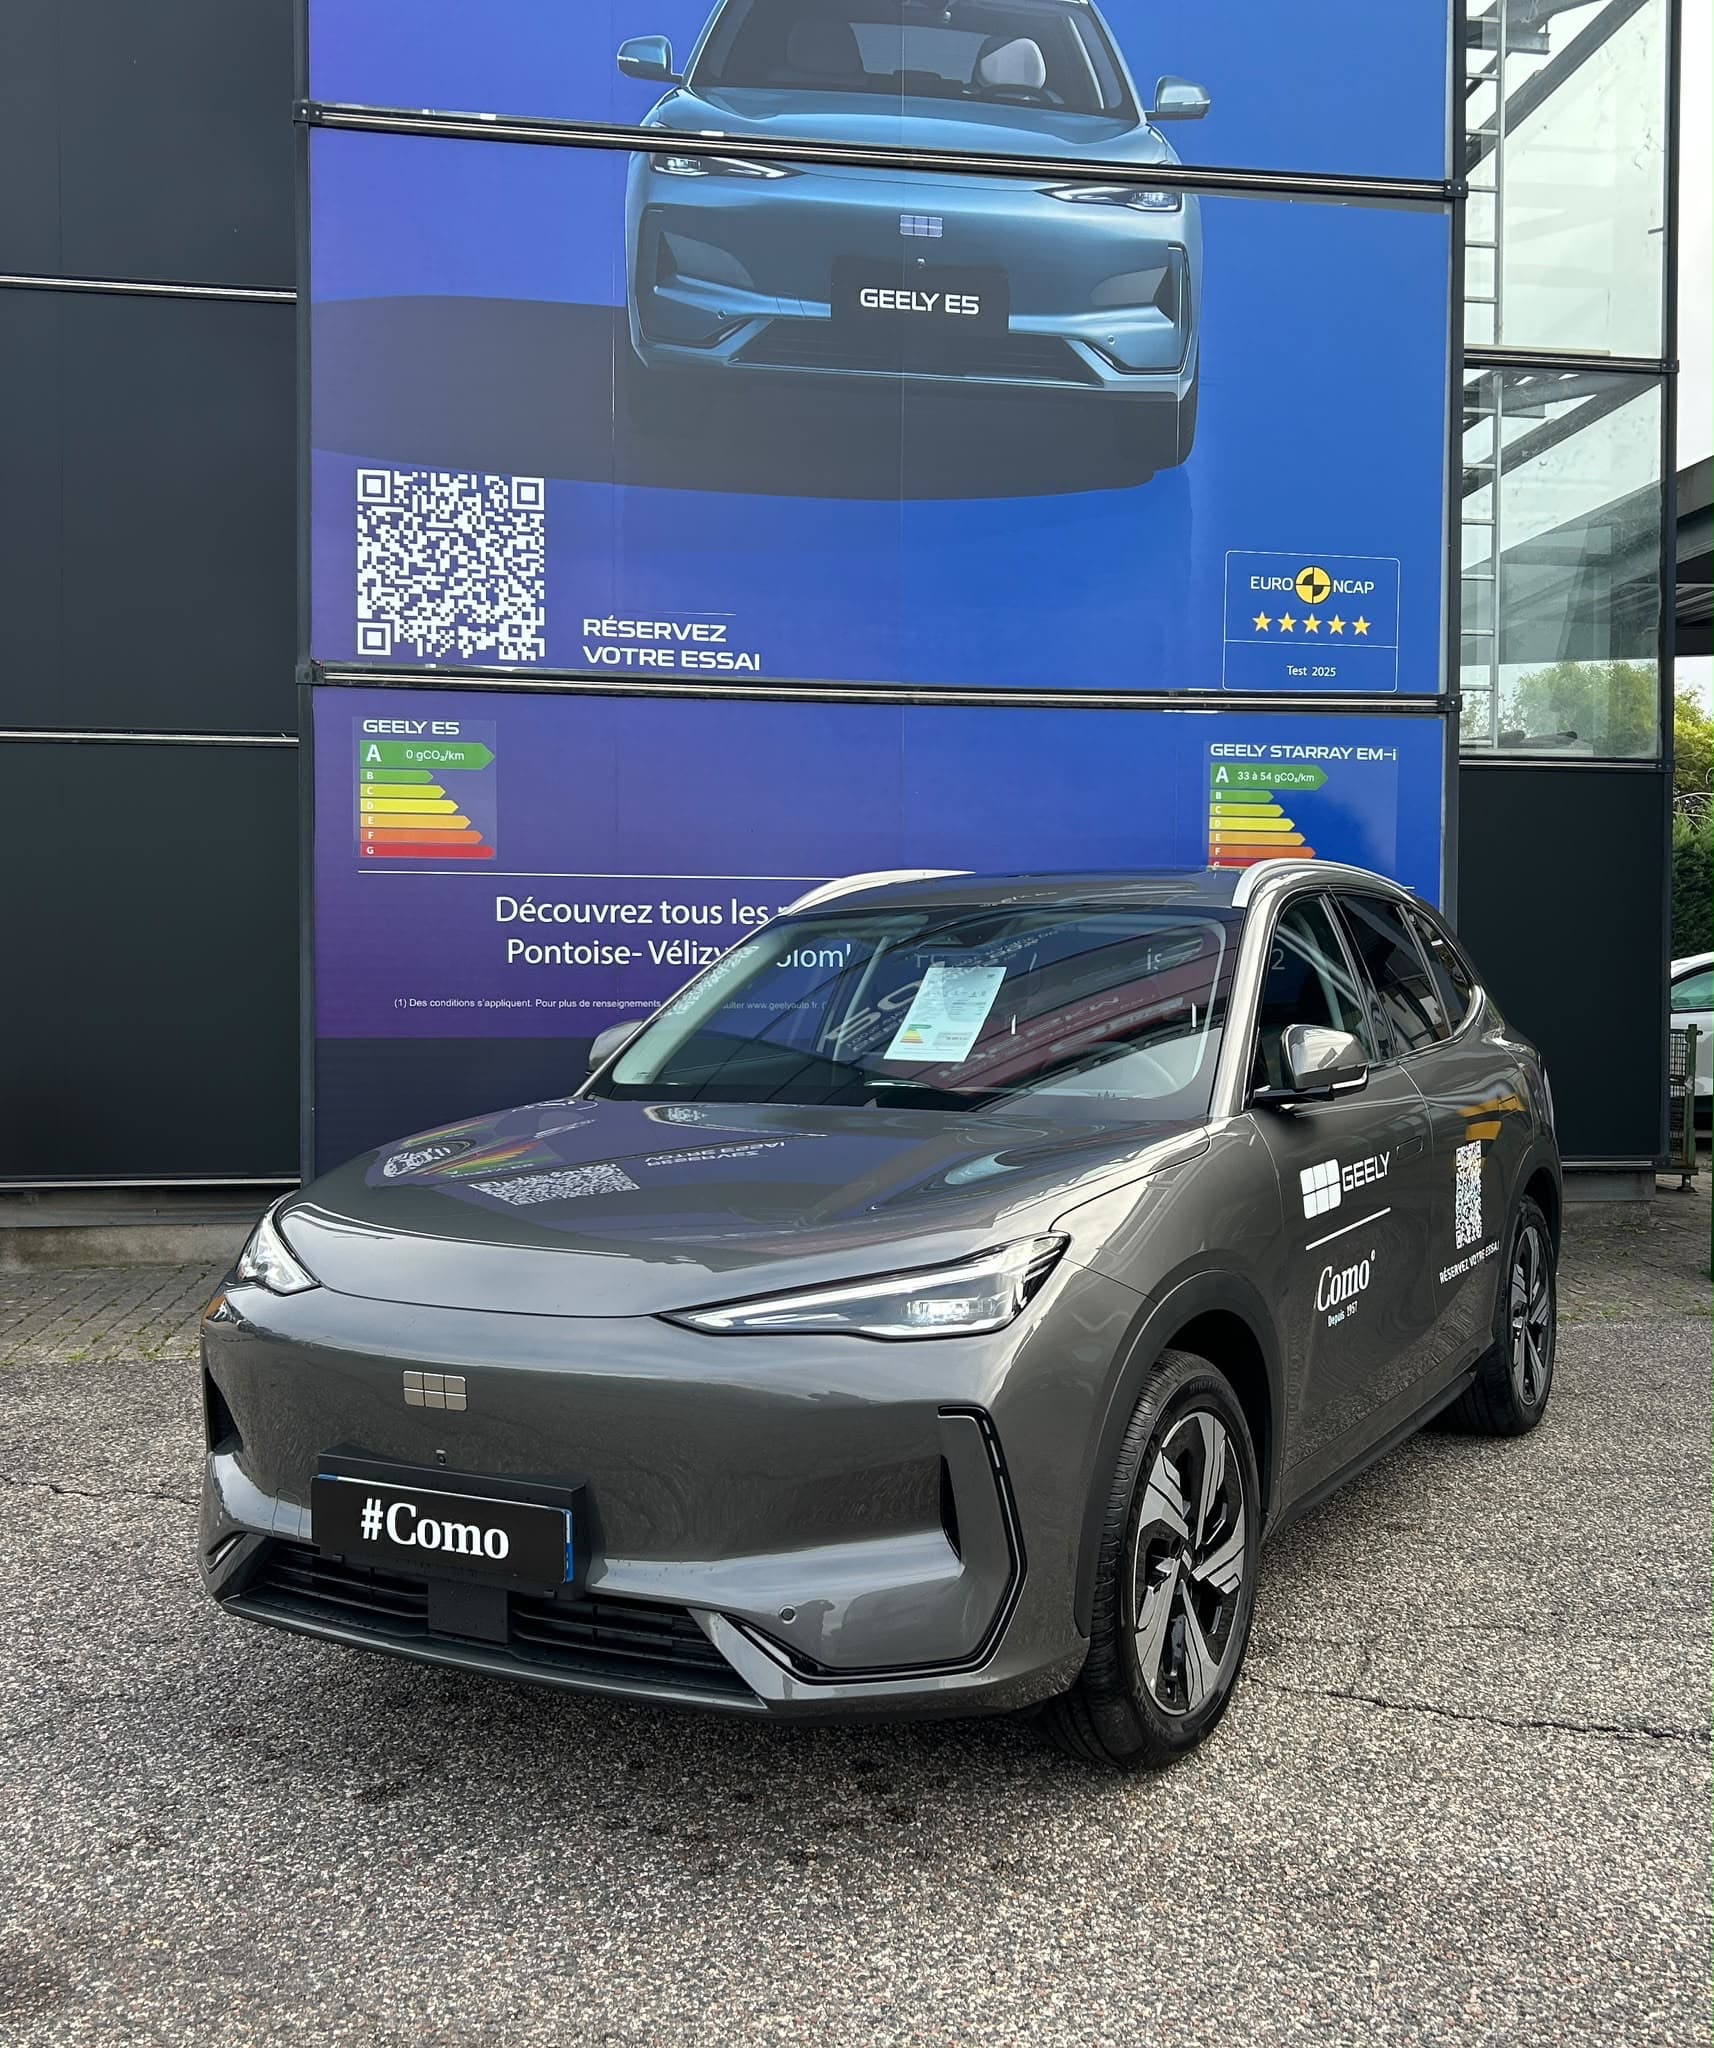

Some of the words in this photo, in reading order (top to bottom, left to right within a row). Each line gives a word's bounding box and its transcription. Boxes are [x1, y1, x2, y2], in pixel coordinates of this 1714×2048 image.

[860, 288, 940, 312] GEELY
[944, 293, 980, 315] E5
[1250, 576, 1294, 591] EURO
[1333, 580, 1375, 594] NCAP
[583, 614, 727, 643] RÉSERVEZ
[583, 645, 675, 667] VOTRE
[681, 650, 761, 671] ESSAI
[1286, 665, 1307, 676] Test
[1312, 666, 1337, 677] 2025
[363, 719, 428, 735] GEELY
[431, 721, 460, 735] E5
[366, 744, 382, 762] A
[406, 750, 414, 759] 0
[1210, 743, 1267, 758] GEELY
[1270, 745, 1353, 760] STARRAY
[1356, 747, 1397, 761] EM-i
[367, 772, 374, 780] B
[1215, 766, 1229, 783] A
[1237, 772, 1250, 781] 33
[1252, 771, 1258, 781] à
[1260, 772, 1272, 781] 54
[367, 787, 374, 795] C
[367, 801, 374, 810] D
[1215, 806, 1221, 814] C
[368, 816, 374, 825] E
[1215, 819, 1221, 828] D
[368, 831, 374, 840] F
[1215, 833, 1221, 842] E
[366, 846, 374, 855] G
[495, 896, 653, 924] Découvrez
[660, 902, 723, 925] tous
[731, 898, 769, 925] les
[507, 938, 642, 966] Pontoise-
[394, 999, 407, 1009] (1)
[409, 998, 428, 1008] Des
[430, 998, 475, 1008] conditions
[535, 999, 557, 1008] Pour
[558, 999, 577, 1009] plus
[578, 999, 591, 1008] de
[593, 999, 662, 1010] renseignements
[1341, 1151, 1390, 1192] GEELY
[1439, 1258, 1470, 1284] RÉSERVEZ
[1468, 1248, 1485, 1267] VOTRE
[1485, 1239, 1500, 1257] ESSAI
[1327, 1309, 1346, 1327] Depuis
[1346, 1300, 1358, 1317] 1957
[360, 1497, 510, 1560] #Como
